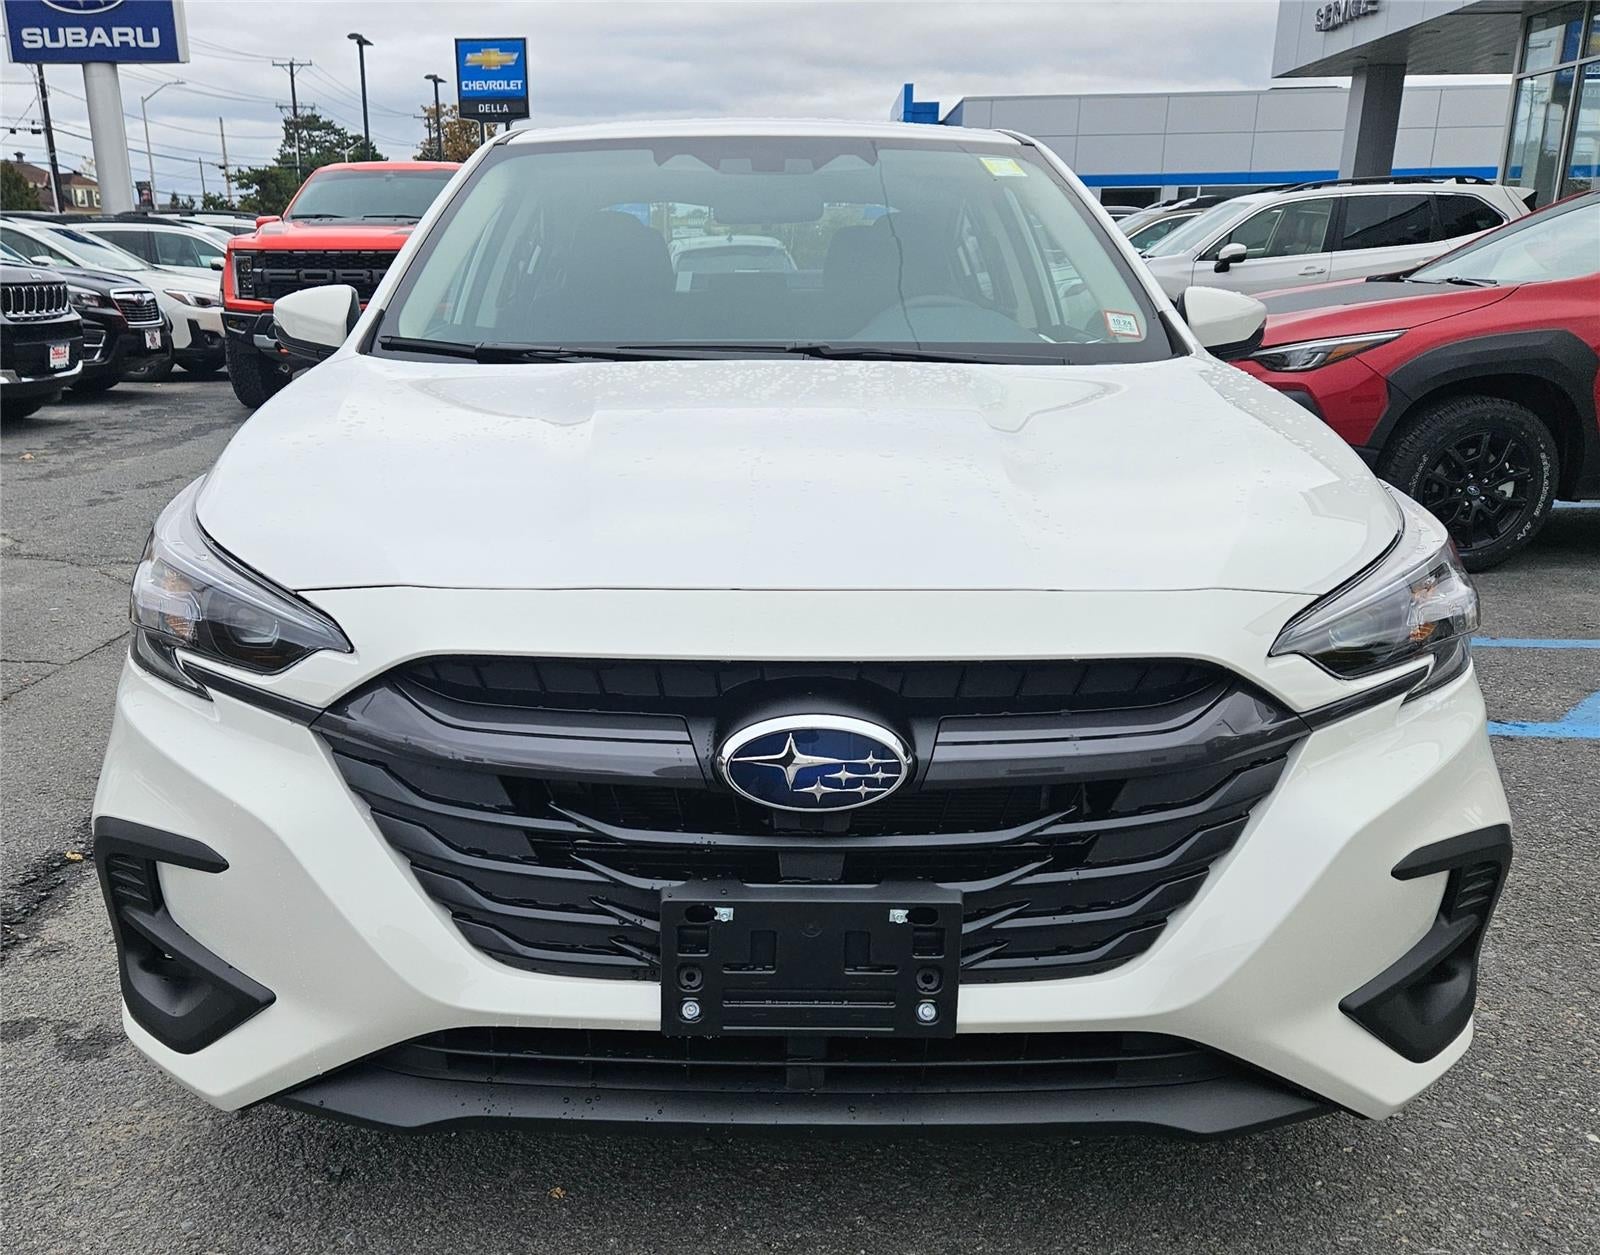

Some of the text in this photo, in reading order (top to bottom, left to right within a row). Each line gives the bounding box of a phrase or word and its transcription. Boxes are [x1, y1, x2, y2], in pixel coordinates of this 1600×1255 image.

[21, 27, 161, 48] SUBARU
[461, 80, 523, 91] CHEVROLET
[478, 103, 509, 113] DELLA
